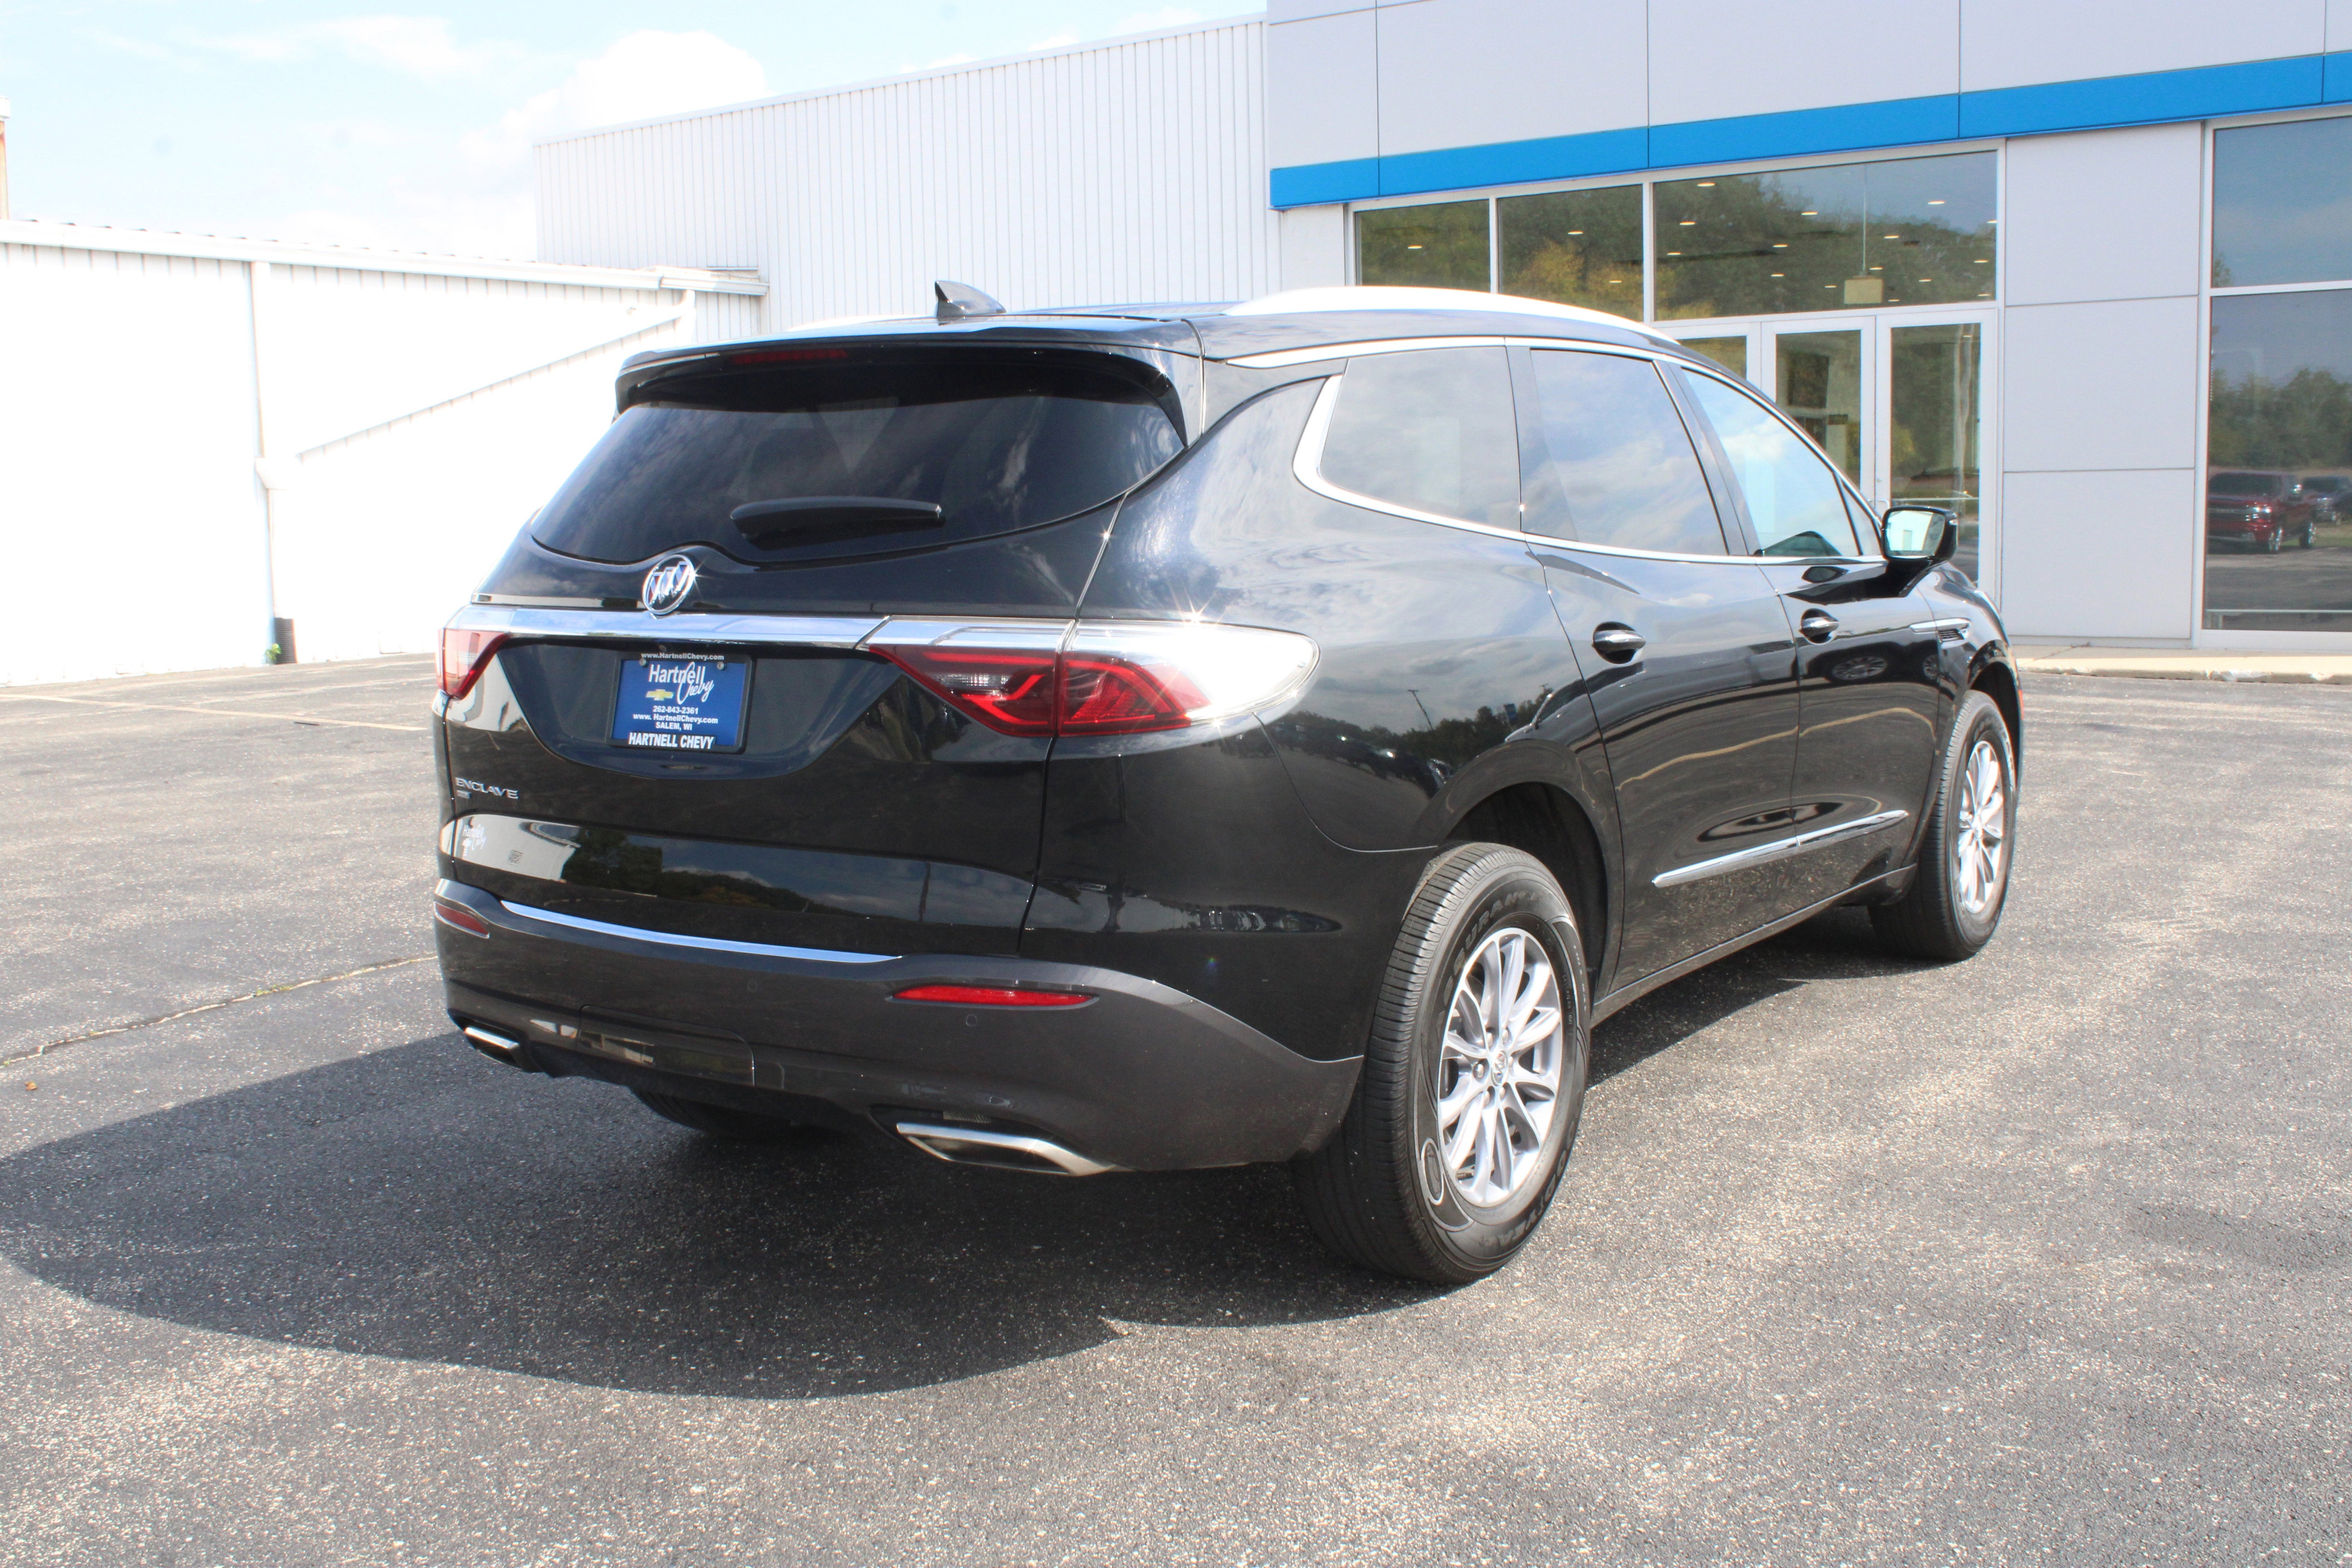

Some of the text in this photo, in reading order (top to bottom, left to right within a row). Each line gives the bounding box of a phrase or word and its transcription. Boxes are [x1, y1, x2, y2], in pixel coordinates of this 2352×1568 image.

[641, 652, 724, 661] www.HartnellChevy.com
[648, 663, 706, 684] Hartnell
[676, 662, 715, 705] Chevy
[653, 705, 699, 714] 262-843-2361
[655, 722, 682, 731] SALEM,
[628, 733, 715, 749] HARTNELL CHEVY
[455, 777, 519, 799] ENCLAVE
